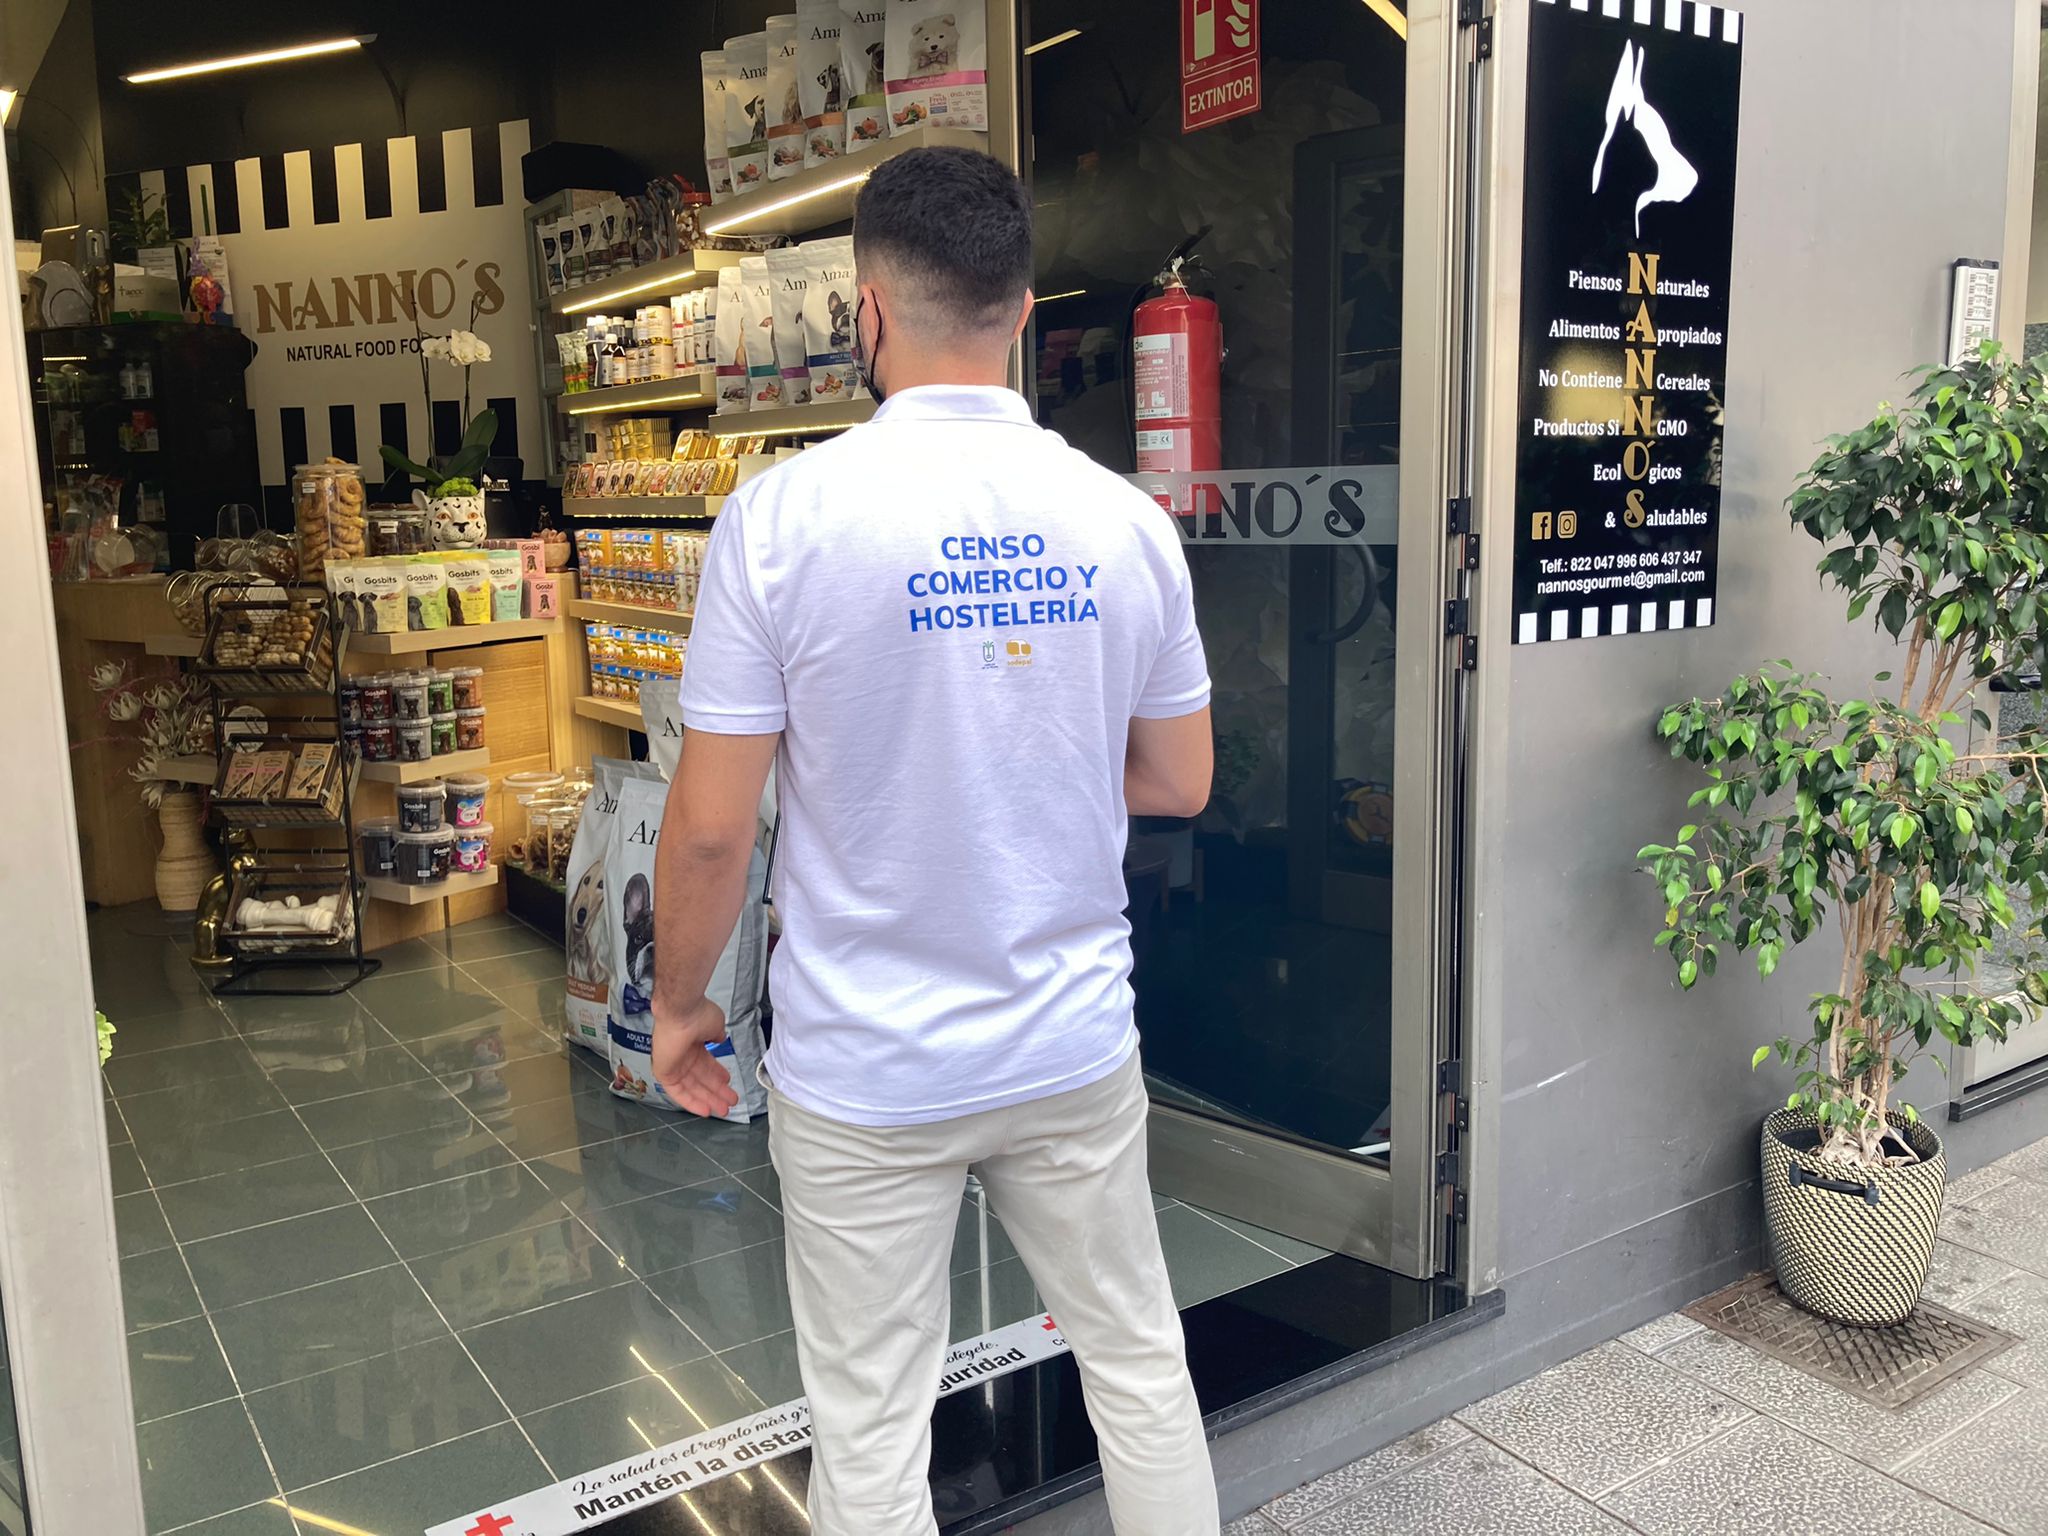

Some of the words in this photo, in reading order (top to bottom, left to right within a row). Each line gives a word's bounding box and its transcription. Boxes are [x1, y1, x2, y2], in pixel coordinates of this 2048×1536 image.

[1188, 75, 1254, 115] EXTINTOR
[1568, 270, 1623, 292] Piensos
[1549, 318, 1621, 340] Alimentos
[286, 342, 352, 363] NATURAL
[355, 339, 396, 358] FOOD
[1538, 368, 1559, 388] No
[1656, 372, 1711, 392] Cereales
[1533, 417, 1605, 437] Productos
[1656, 419, 1688, 437] GMO
[1604, 511, 1616, 529] &
[941, 533, 1045, 561] CENSO
[448, 569, 481, 579] Gosbits
[1540, 559, 1568, 574] Telf.:
[1570, 556, 1592, 572] 822
[1593, 555, 1616, 570] 047
[1616, 554, 1637, 568] 996
[1639, 552, 1659, 567] 606
[1661, 551, 1681, 565] 437
[1682, 550, 1702, 564] 347
[364, 574, 397, 585] Gosbits
[406, 573, 439, 583] Gosbits
[907, 566, 1068, 598] COMERCIO
[1076, 565, 1099, 588] Y
[1537, 569, 1705, 595] nannosgourmet@gmail.com
[909, 592, 1099, 632] HOSTELERÍA
[626, 1032, 645, 1044] ADULT
[572, 1480, 605, 1496] La
[607, 1457, 657, 1485] salud
[660, 1452, 678, 1466] es
[682, 1443, 698, 1458] el
[698, 1426, 752, 1451] regalo
[755, 1413, 788, 1432] más
[572, 1469, 693, 1521] Mantén
[695, 1457, 728, 1475] la
